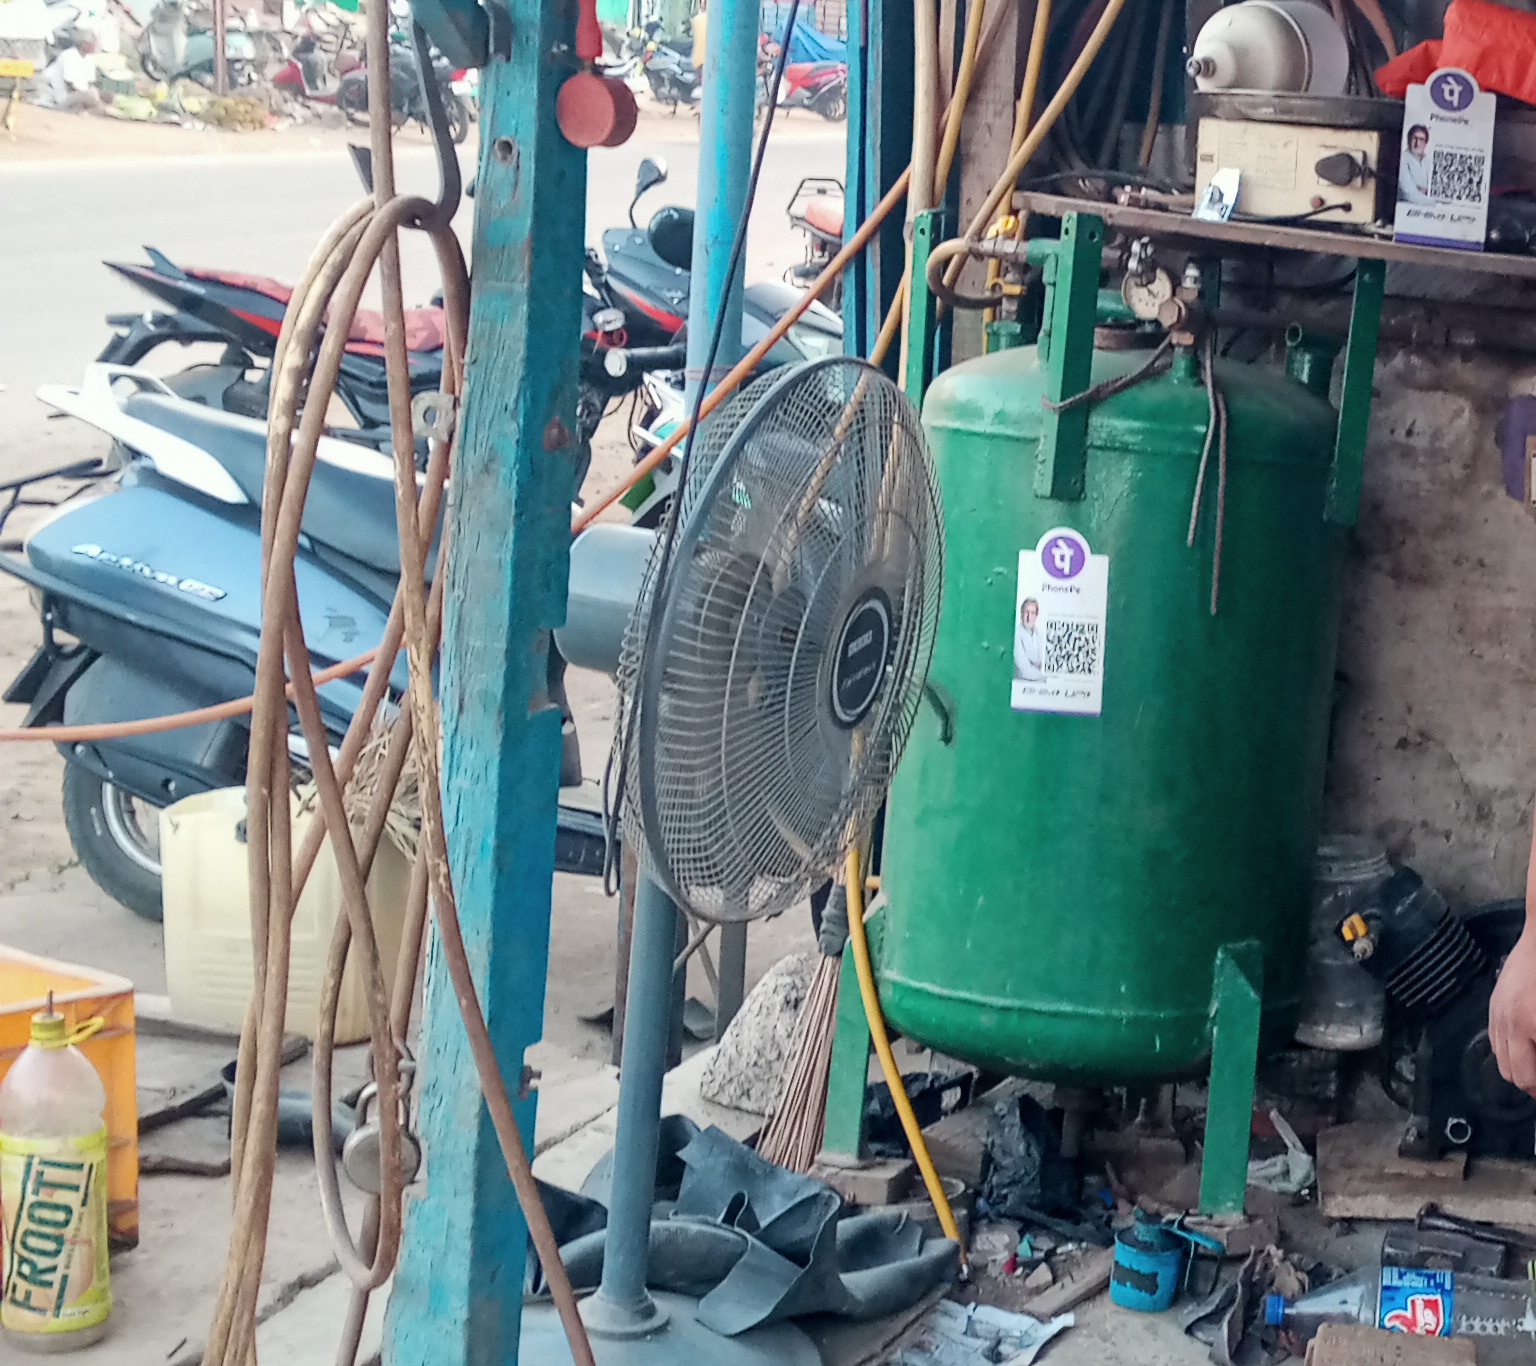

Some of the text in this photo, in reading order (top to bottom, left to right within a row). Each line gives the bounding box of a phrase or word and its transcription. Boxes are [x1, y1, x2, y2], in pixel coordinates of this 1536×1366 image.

[1430, 113, 1470, 126] PhonePe
[1041, 583, 1081, 595] PhonePe
[9, 1156, 85, 1317] FROOTI
